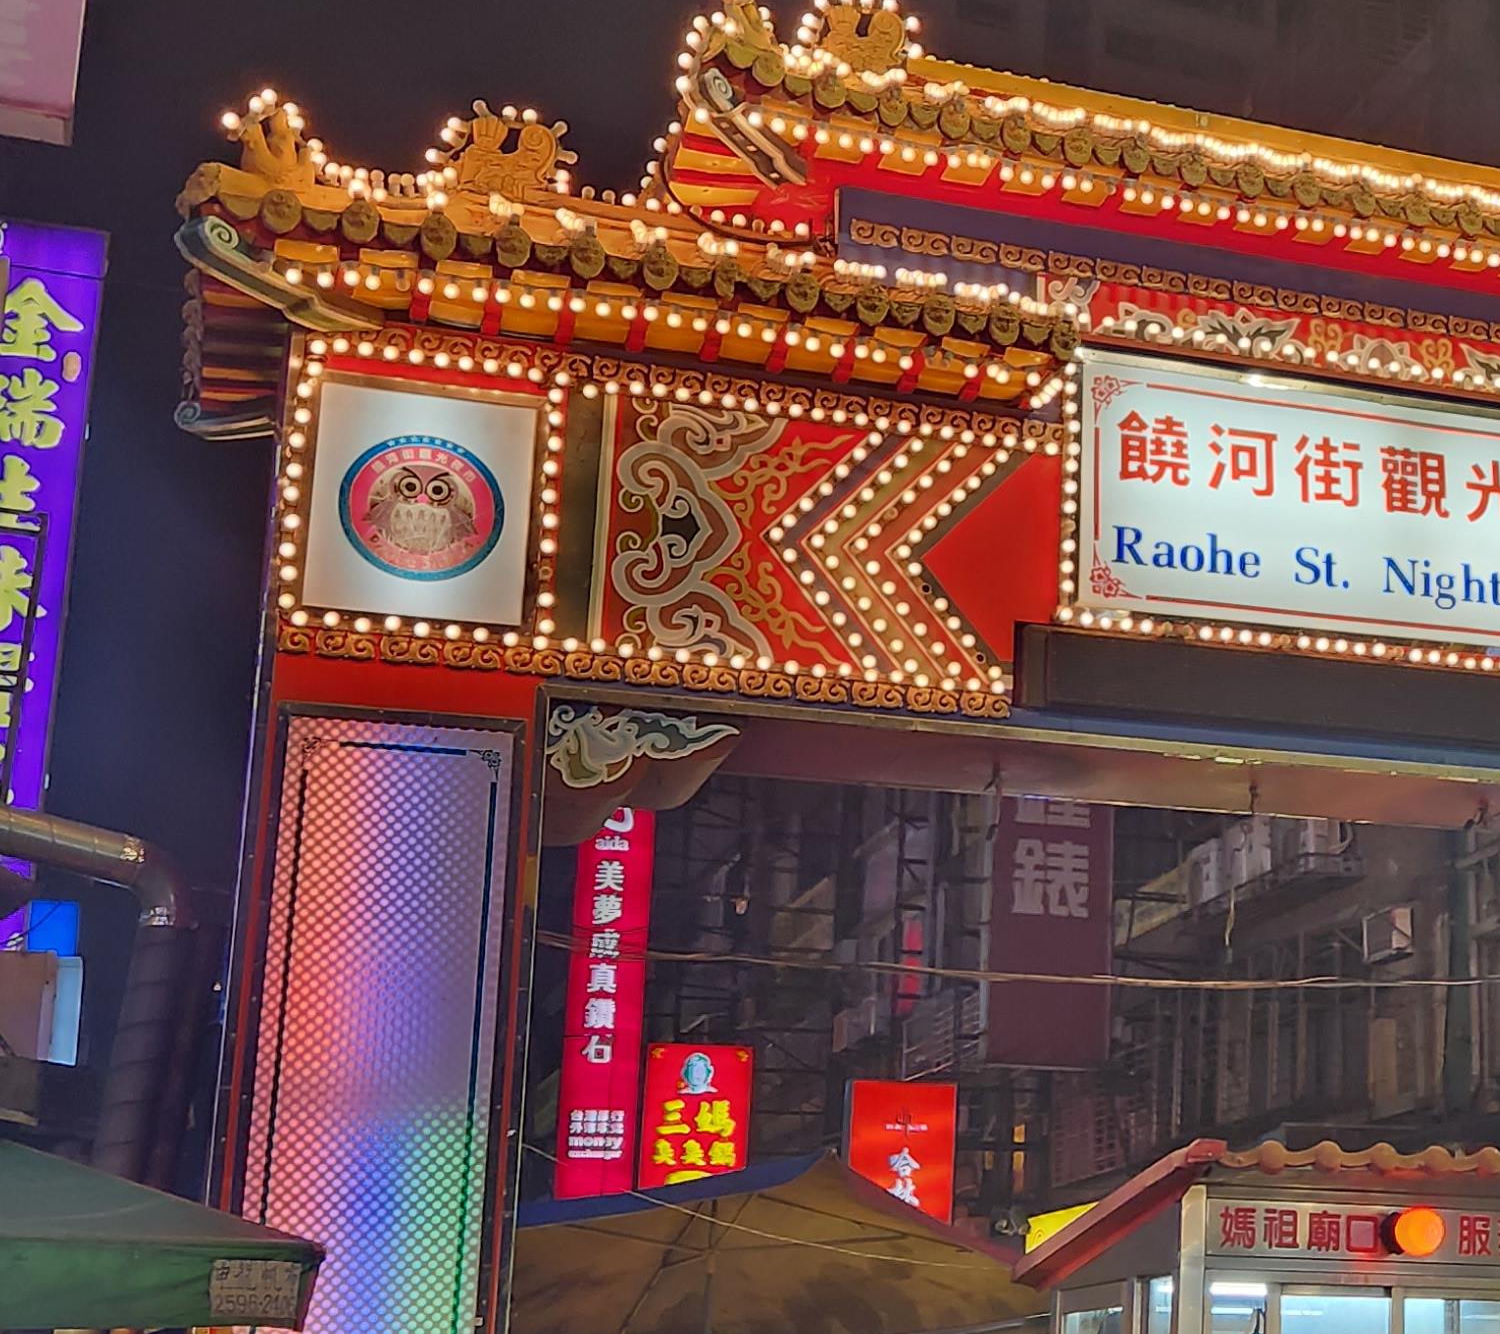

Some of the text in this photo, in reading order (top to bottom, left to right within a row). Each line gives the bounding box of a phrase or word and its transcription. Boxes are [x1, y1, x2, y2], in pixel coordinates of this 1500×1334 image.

[1112, 525, 1261, 581] Raohe
[1293, 546, 1350, 589] St.
[656, 1100, 736, 1137] 三媽
[1220, 1205, 1378, 1253] 媽祖廟口
